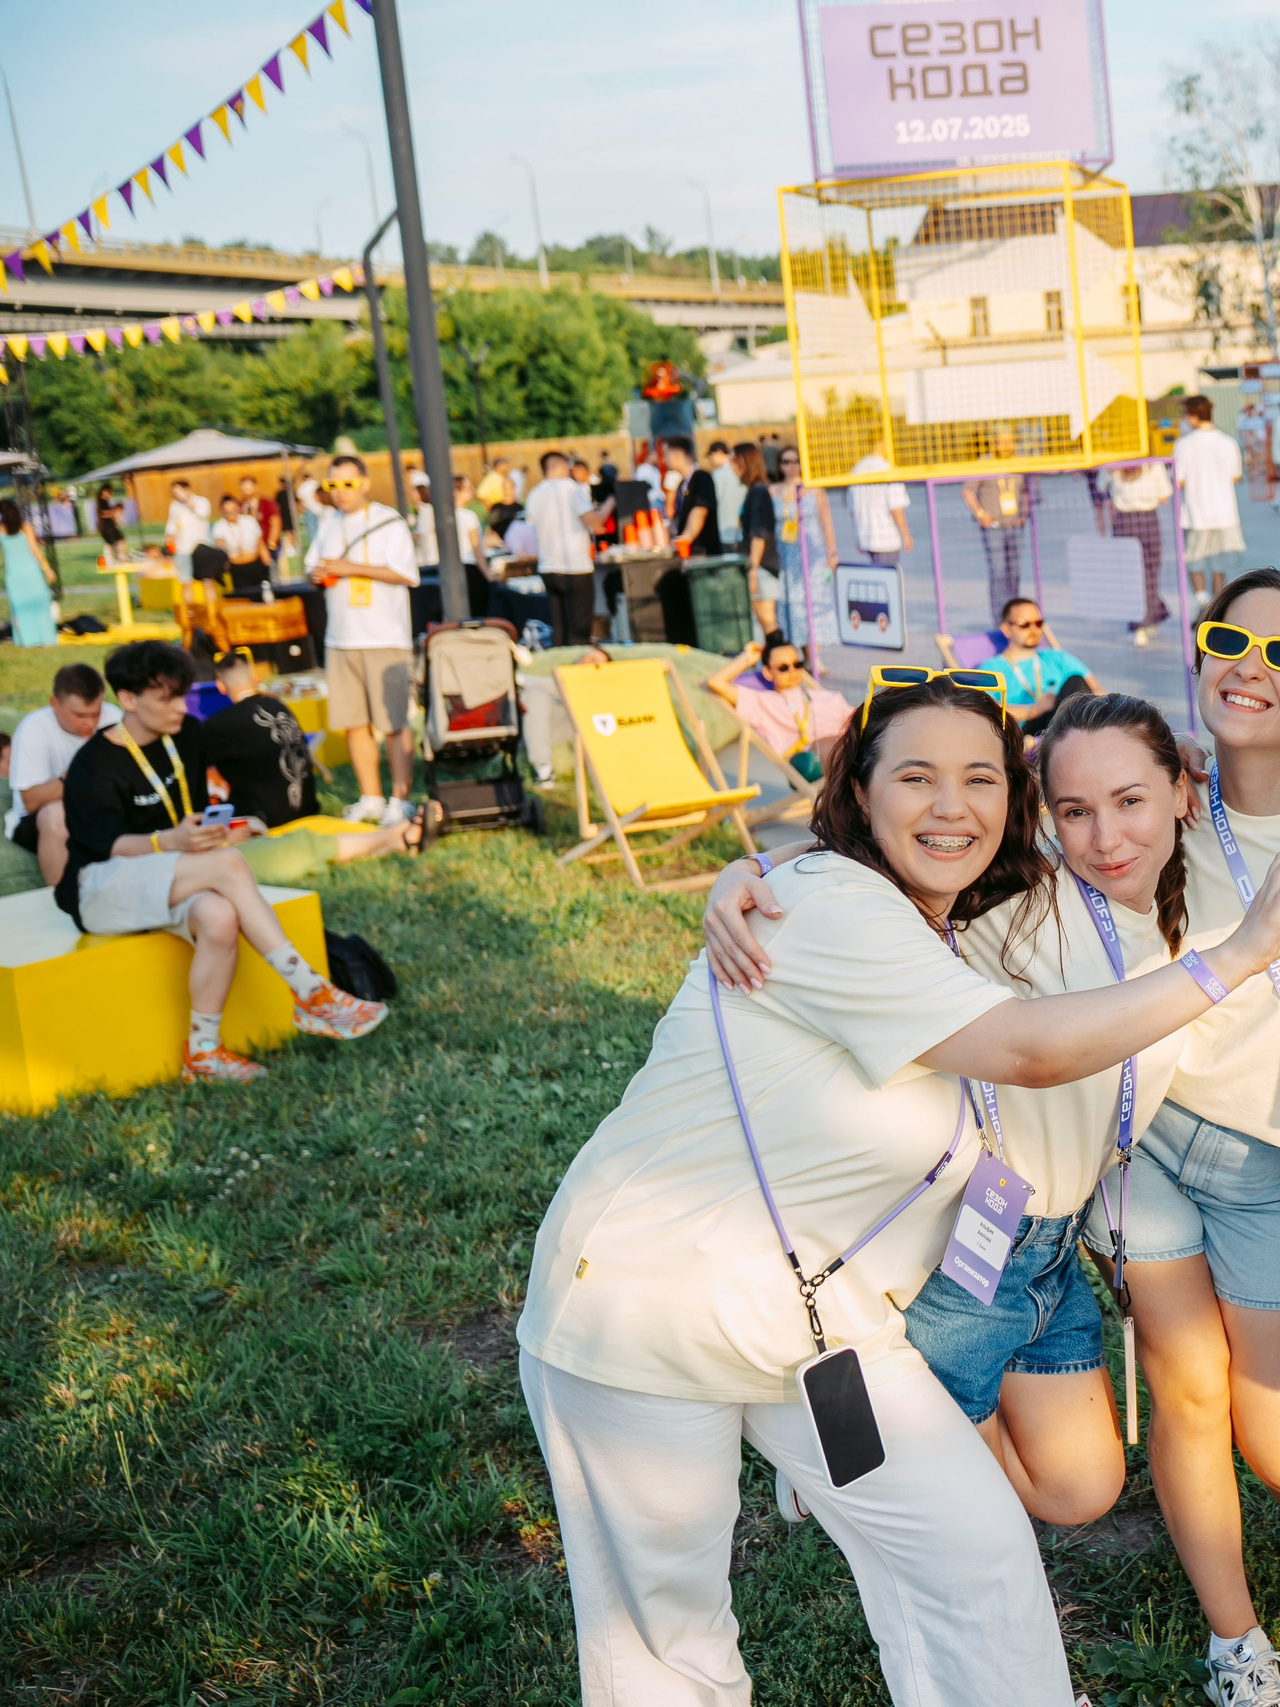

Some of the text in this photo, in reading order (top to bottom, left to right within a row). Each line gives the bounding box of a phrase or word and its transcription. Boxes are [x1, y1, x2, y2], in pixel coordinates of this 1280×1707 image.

[895, 114, 1031, 144] 12.07.2025
[1213, 808, 1237, 856] кода
[1121, 1066, 1133, 1122] сезон
[954, 1256, 990, 1288] Организатор
